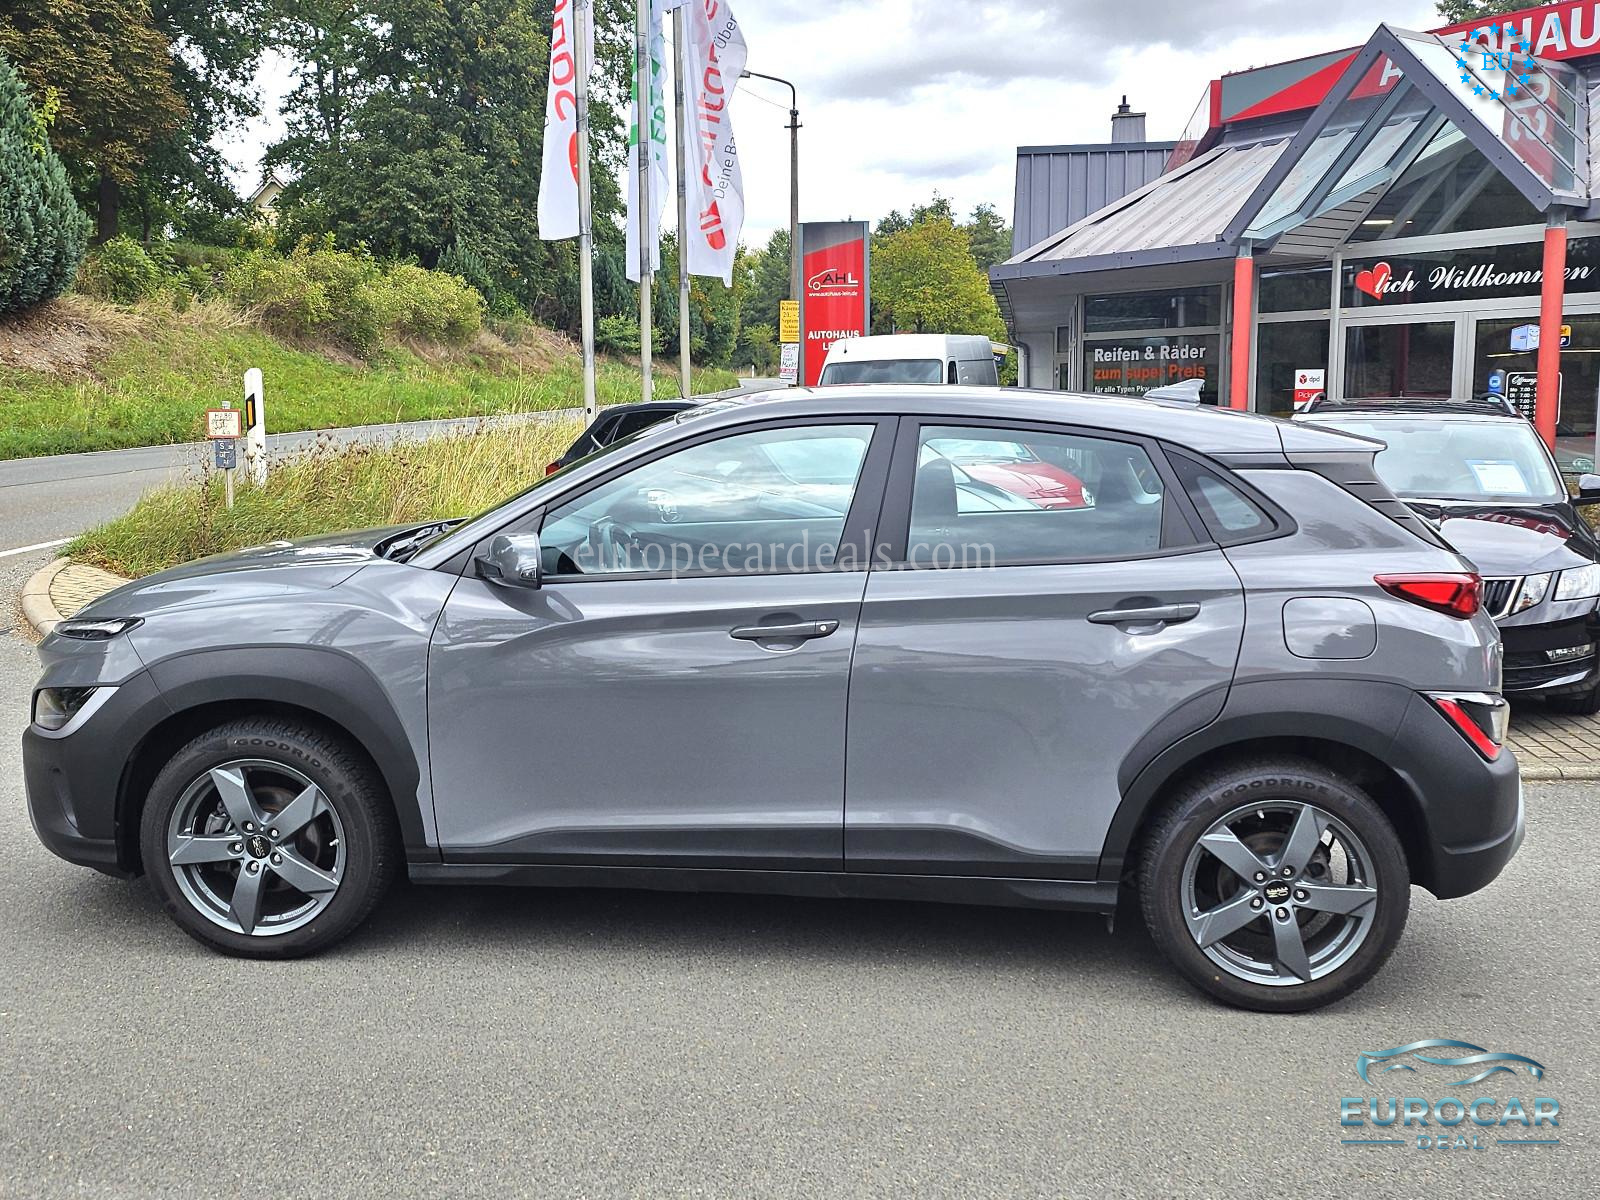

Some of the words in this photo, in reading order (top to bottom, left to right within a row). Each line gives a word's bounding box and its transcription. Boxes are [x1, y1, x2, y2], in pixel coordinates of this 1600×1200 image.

[713, 157, 734, 199] Deine
[823, 272, 859, 284] AHL
[1375, 270, 1420, 294] lich
[808, 330, 860, 339] AUTOHAUS
[1094, 347, 1139, 362] Reifen
[1144, 346, 1155, 360] &
[1160, 344, 1206, 360] Räder
[1094, 368, 1121, 380] zum
[1126, 366, 1164, 382] super
[1168, 363, 1206, 378] Preis
[1117, 385, 1135, 395] Typen
[236, 738, 332, 777] GOODRIDE
[1221, 778, 1330, 799] GOODRIDE
